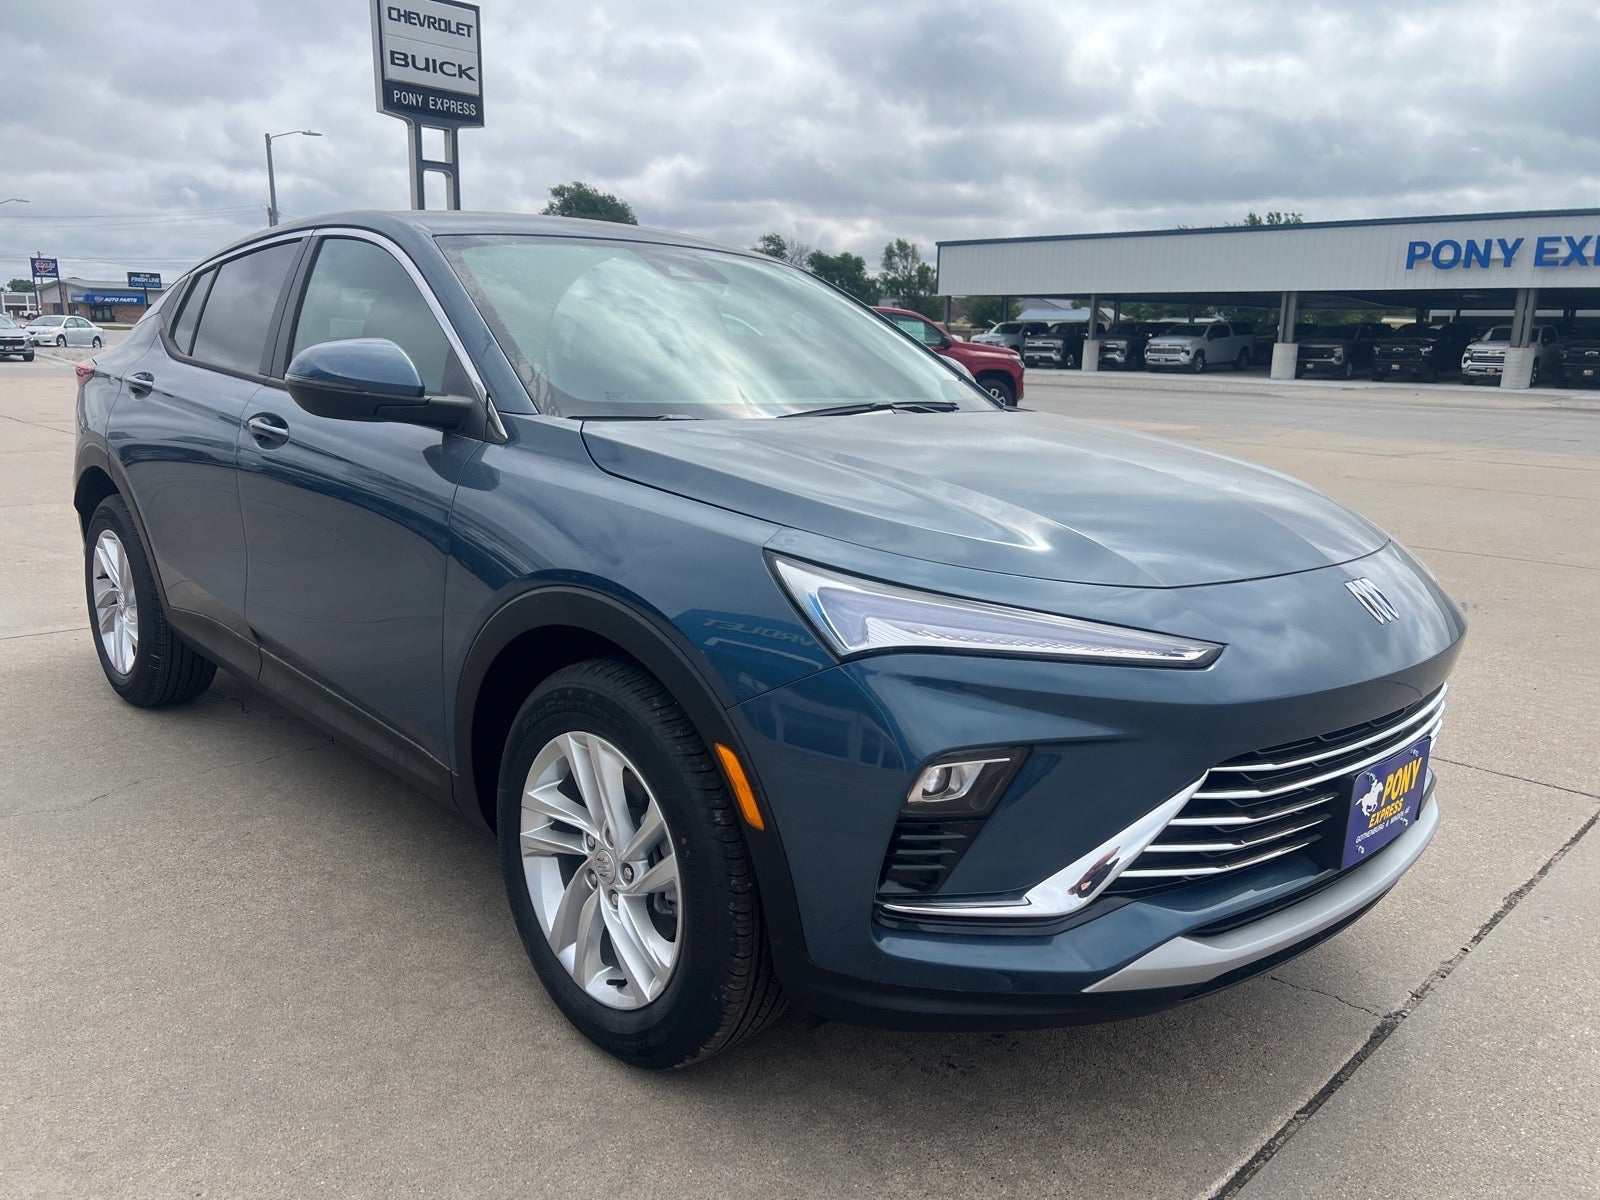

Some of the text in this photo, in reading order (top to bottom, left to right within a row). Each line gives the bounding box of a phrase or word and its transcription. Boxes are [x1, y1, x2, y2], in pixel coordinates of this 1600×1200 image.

[387, 6, 473, 38] CHEVROLET
[389, 49, 477, 82] BUICK
[393, 90, 476, 116] PONY EXPRESS
[1405, 237, 1525, 270] PONY
[1381, 757, 1423, 807] PONY
[1368, 798, 1404, 829] EXPRESS
